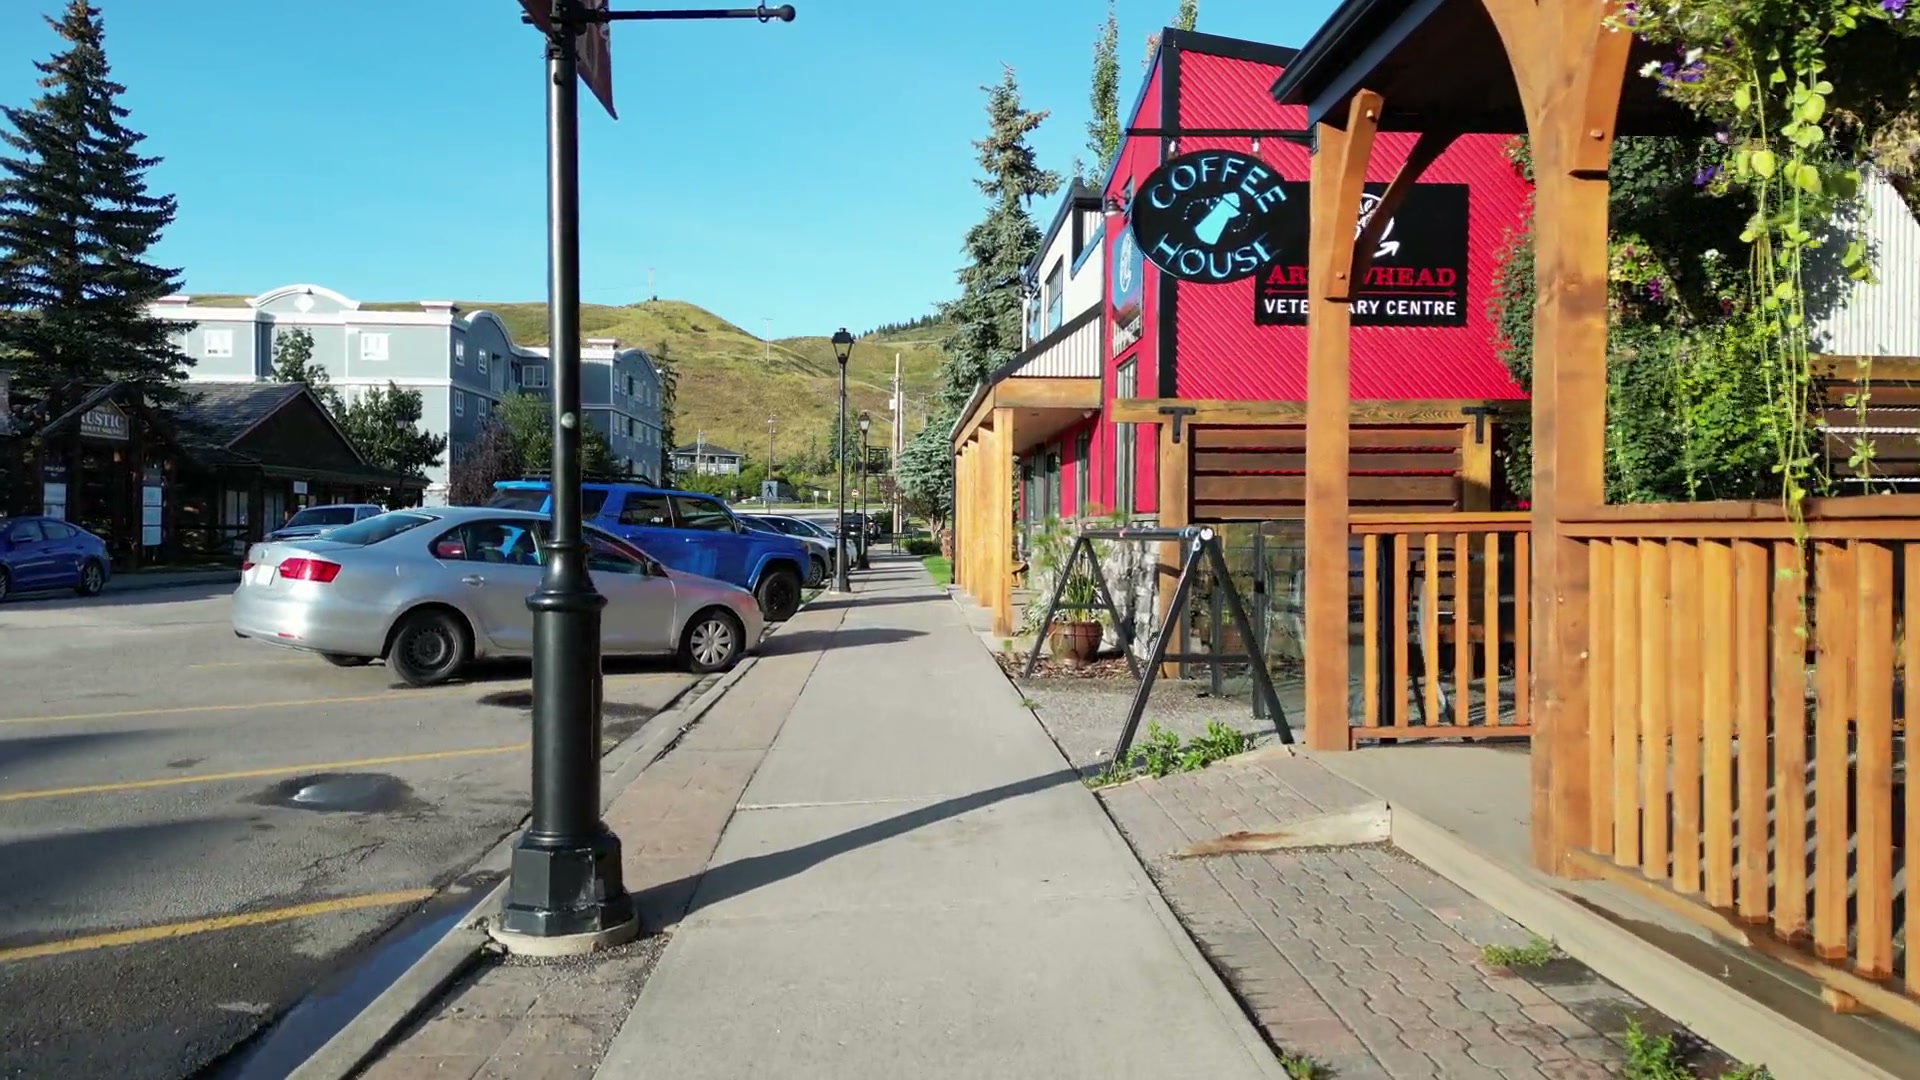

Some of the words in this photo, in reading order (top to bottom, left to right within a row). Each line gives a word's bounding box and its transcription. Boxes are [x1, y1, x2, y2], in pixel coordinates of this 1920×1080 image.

[1151, 156, 1288, 214] COFFEE
[1266, 265, 1457, 287] ARHEAD
[1264, 298, 1380, 316] VETEARY
[1386, 301, 1457, 316] CENTRE
